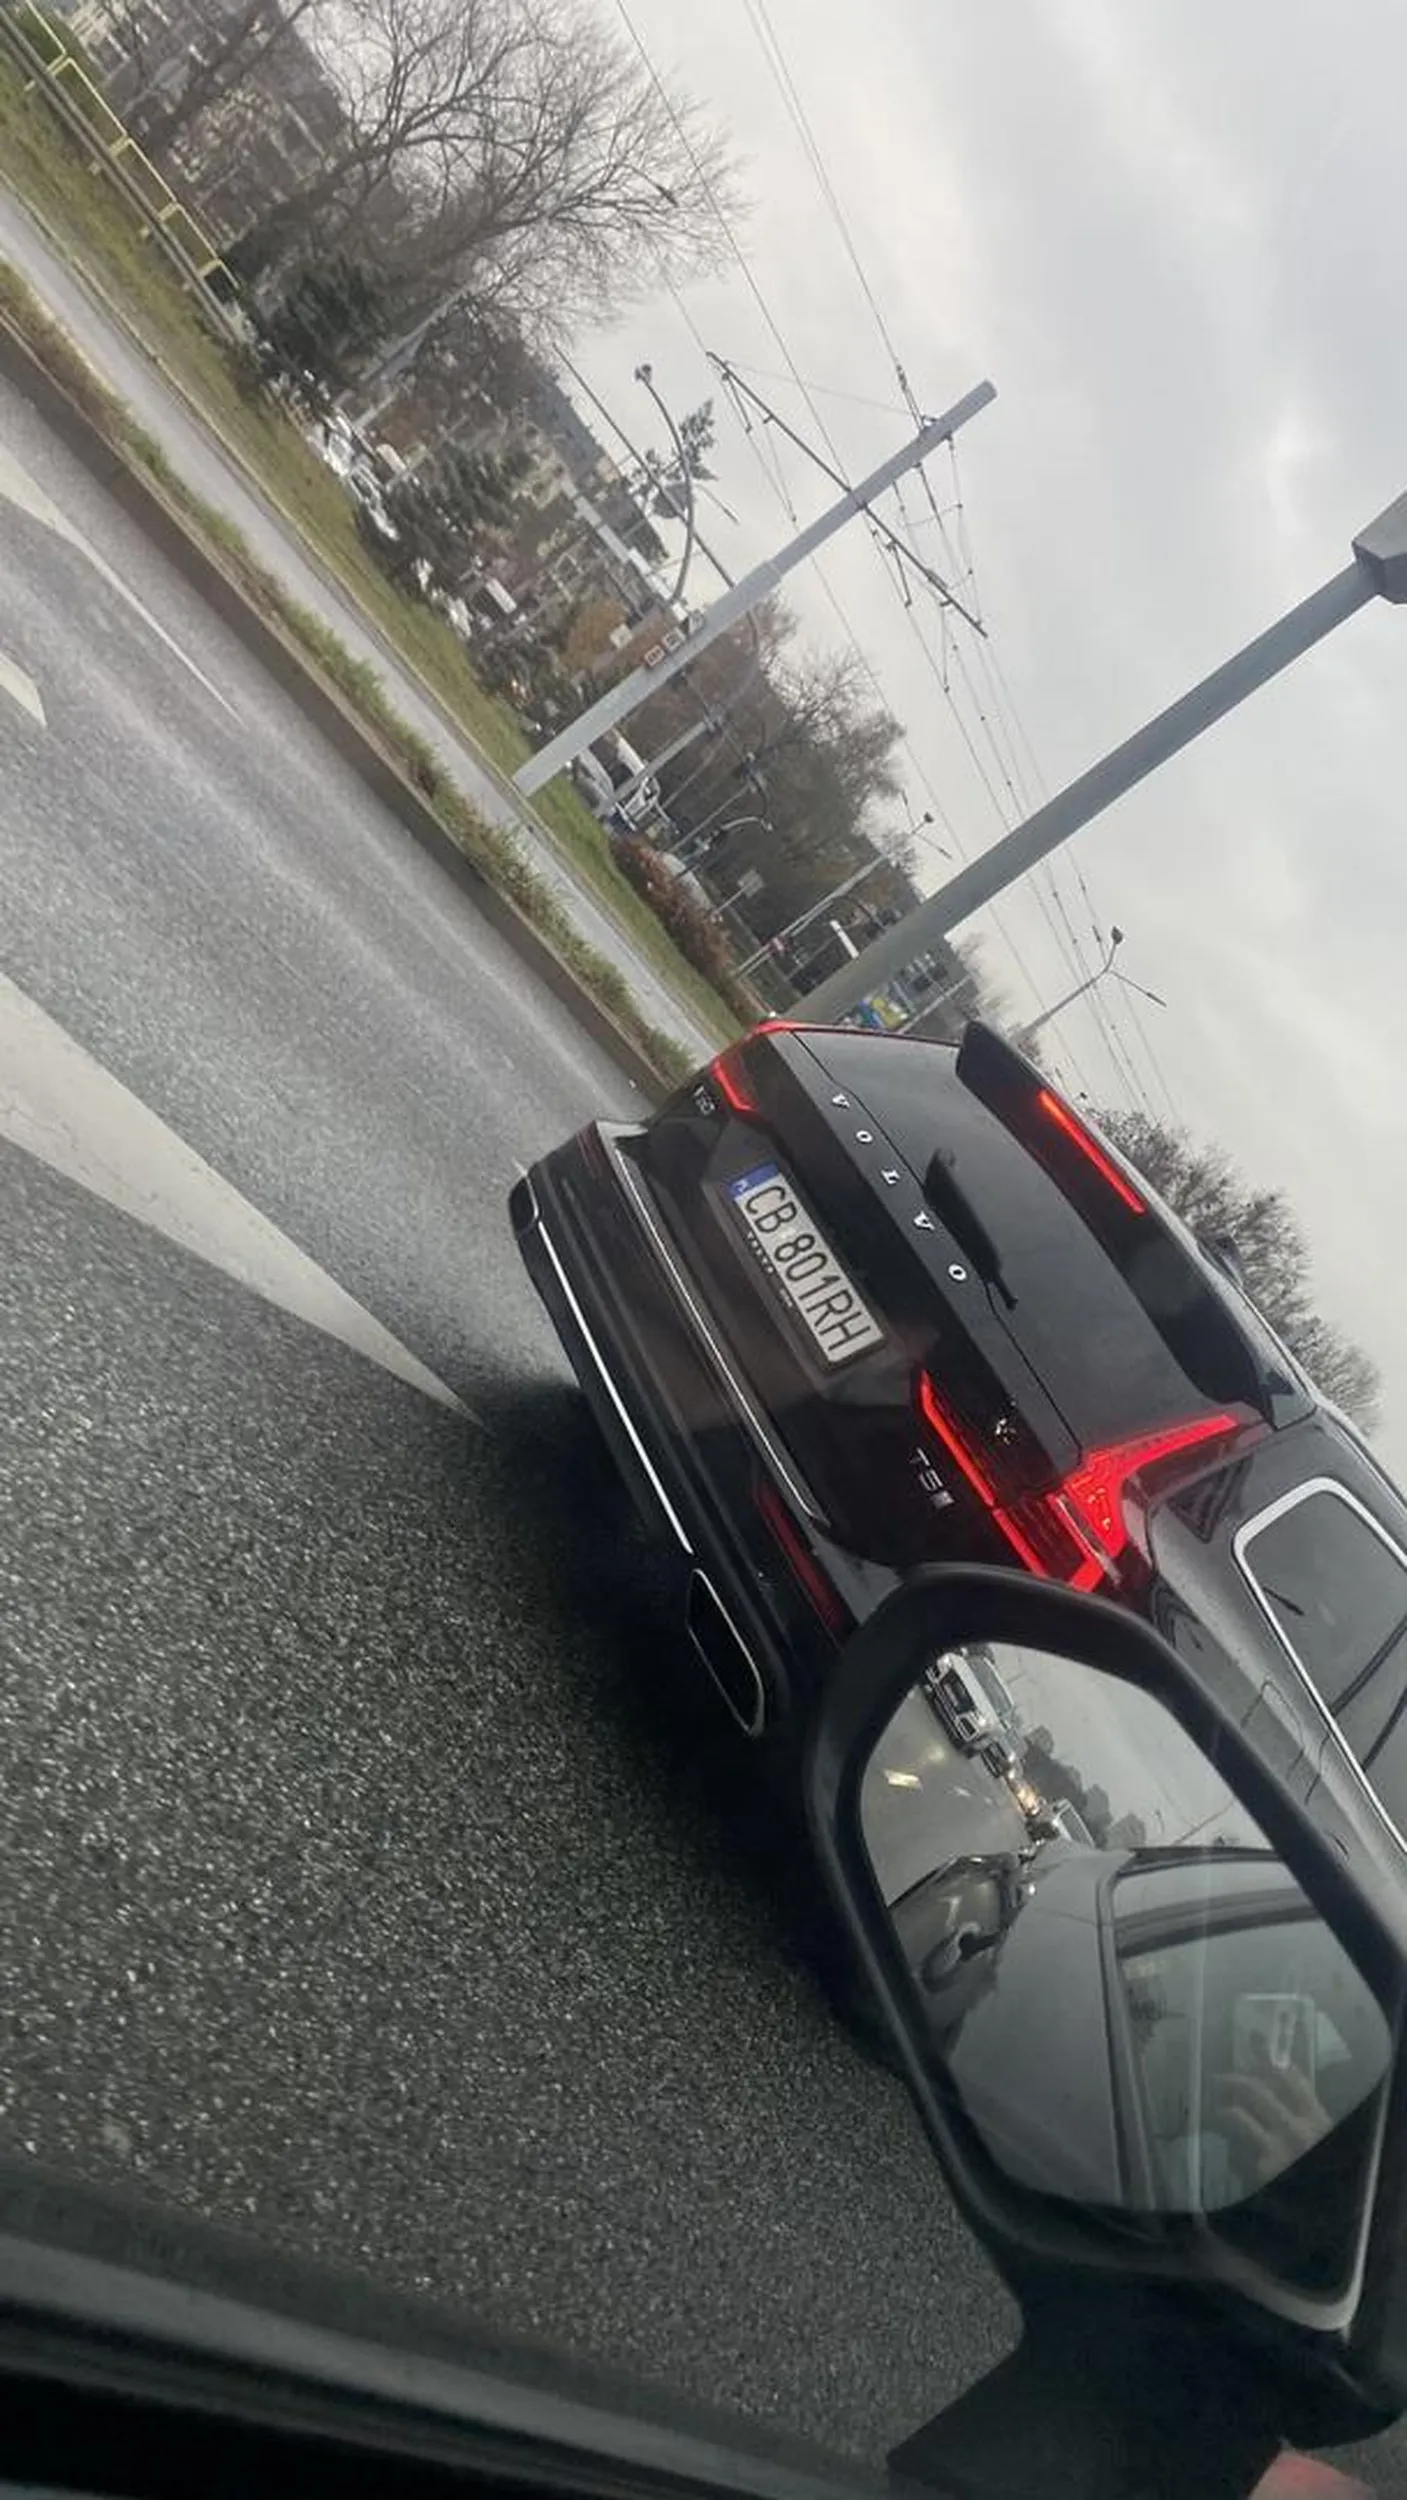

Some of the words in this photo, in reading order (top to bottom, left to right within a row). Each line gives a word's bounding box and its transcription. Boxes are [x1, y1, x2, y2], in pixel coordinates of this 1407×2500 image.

[745, 1185, 797, 1233] CB
[774, 1233, 872, 1352] 801RH
[832, 1093, 967, 1281] VOLVO
